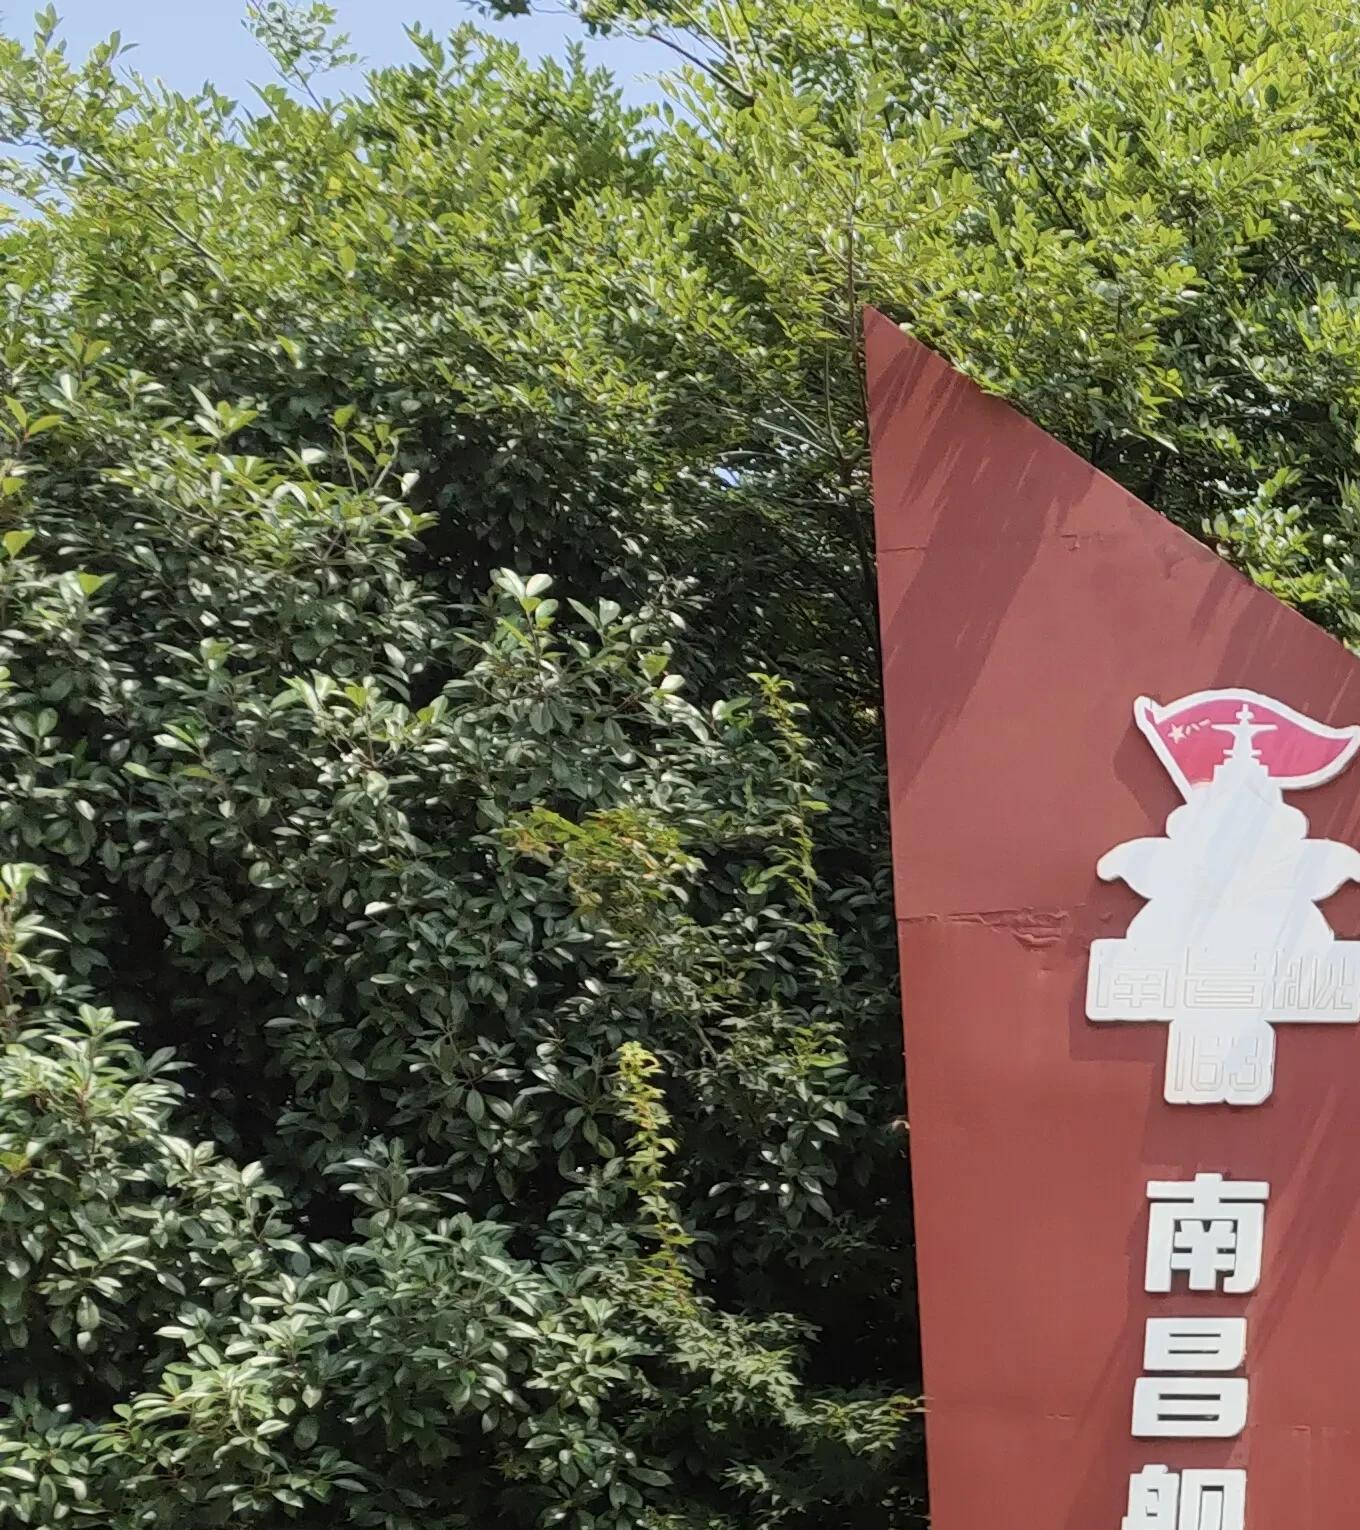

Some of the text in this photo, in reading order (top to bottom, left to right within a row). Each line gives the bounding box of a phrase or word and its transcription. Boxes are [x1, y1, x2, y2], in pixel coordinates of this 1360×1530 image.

[1096, 944, 1354, 1010] 南昌舰
[1173, 1030, 1266, 1092] 163
